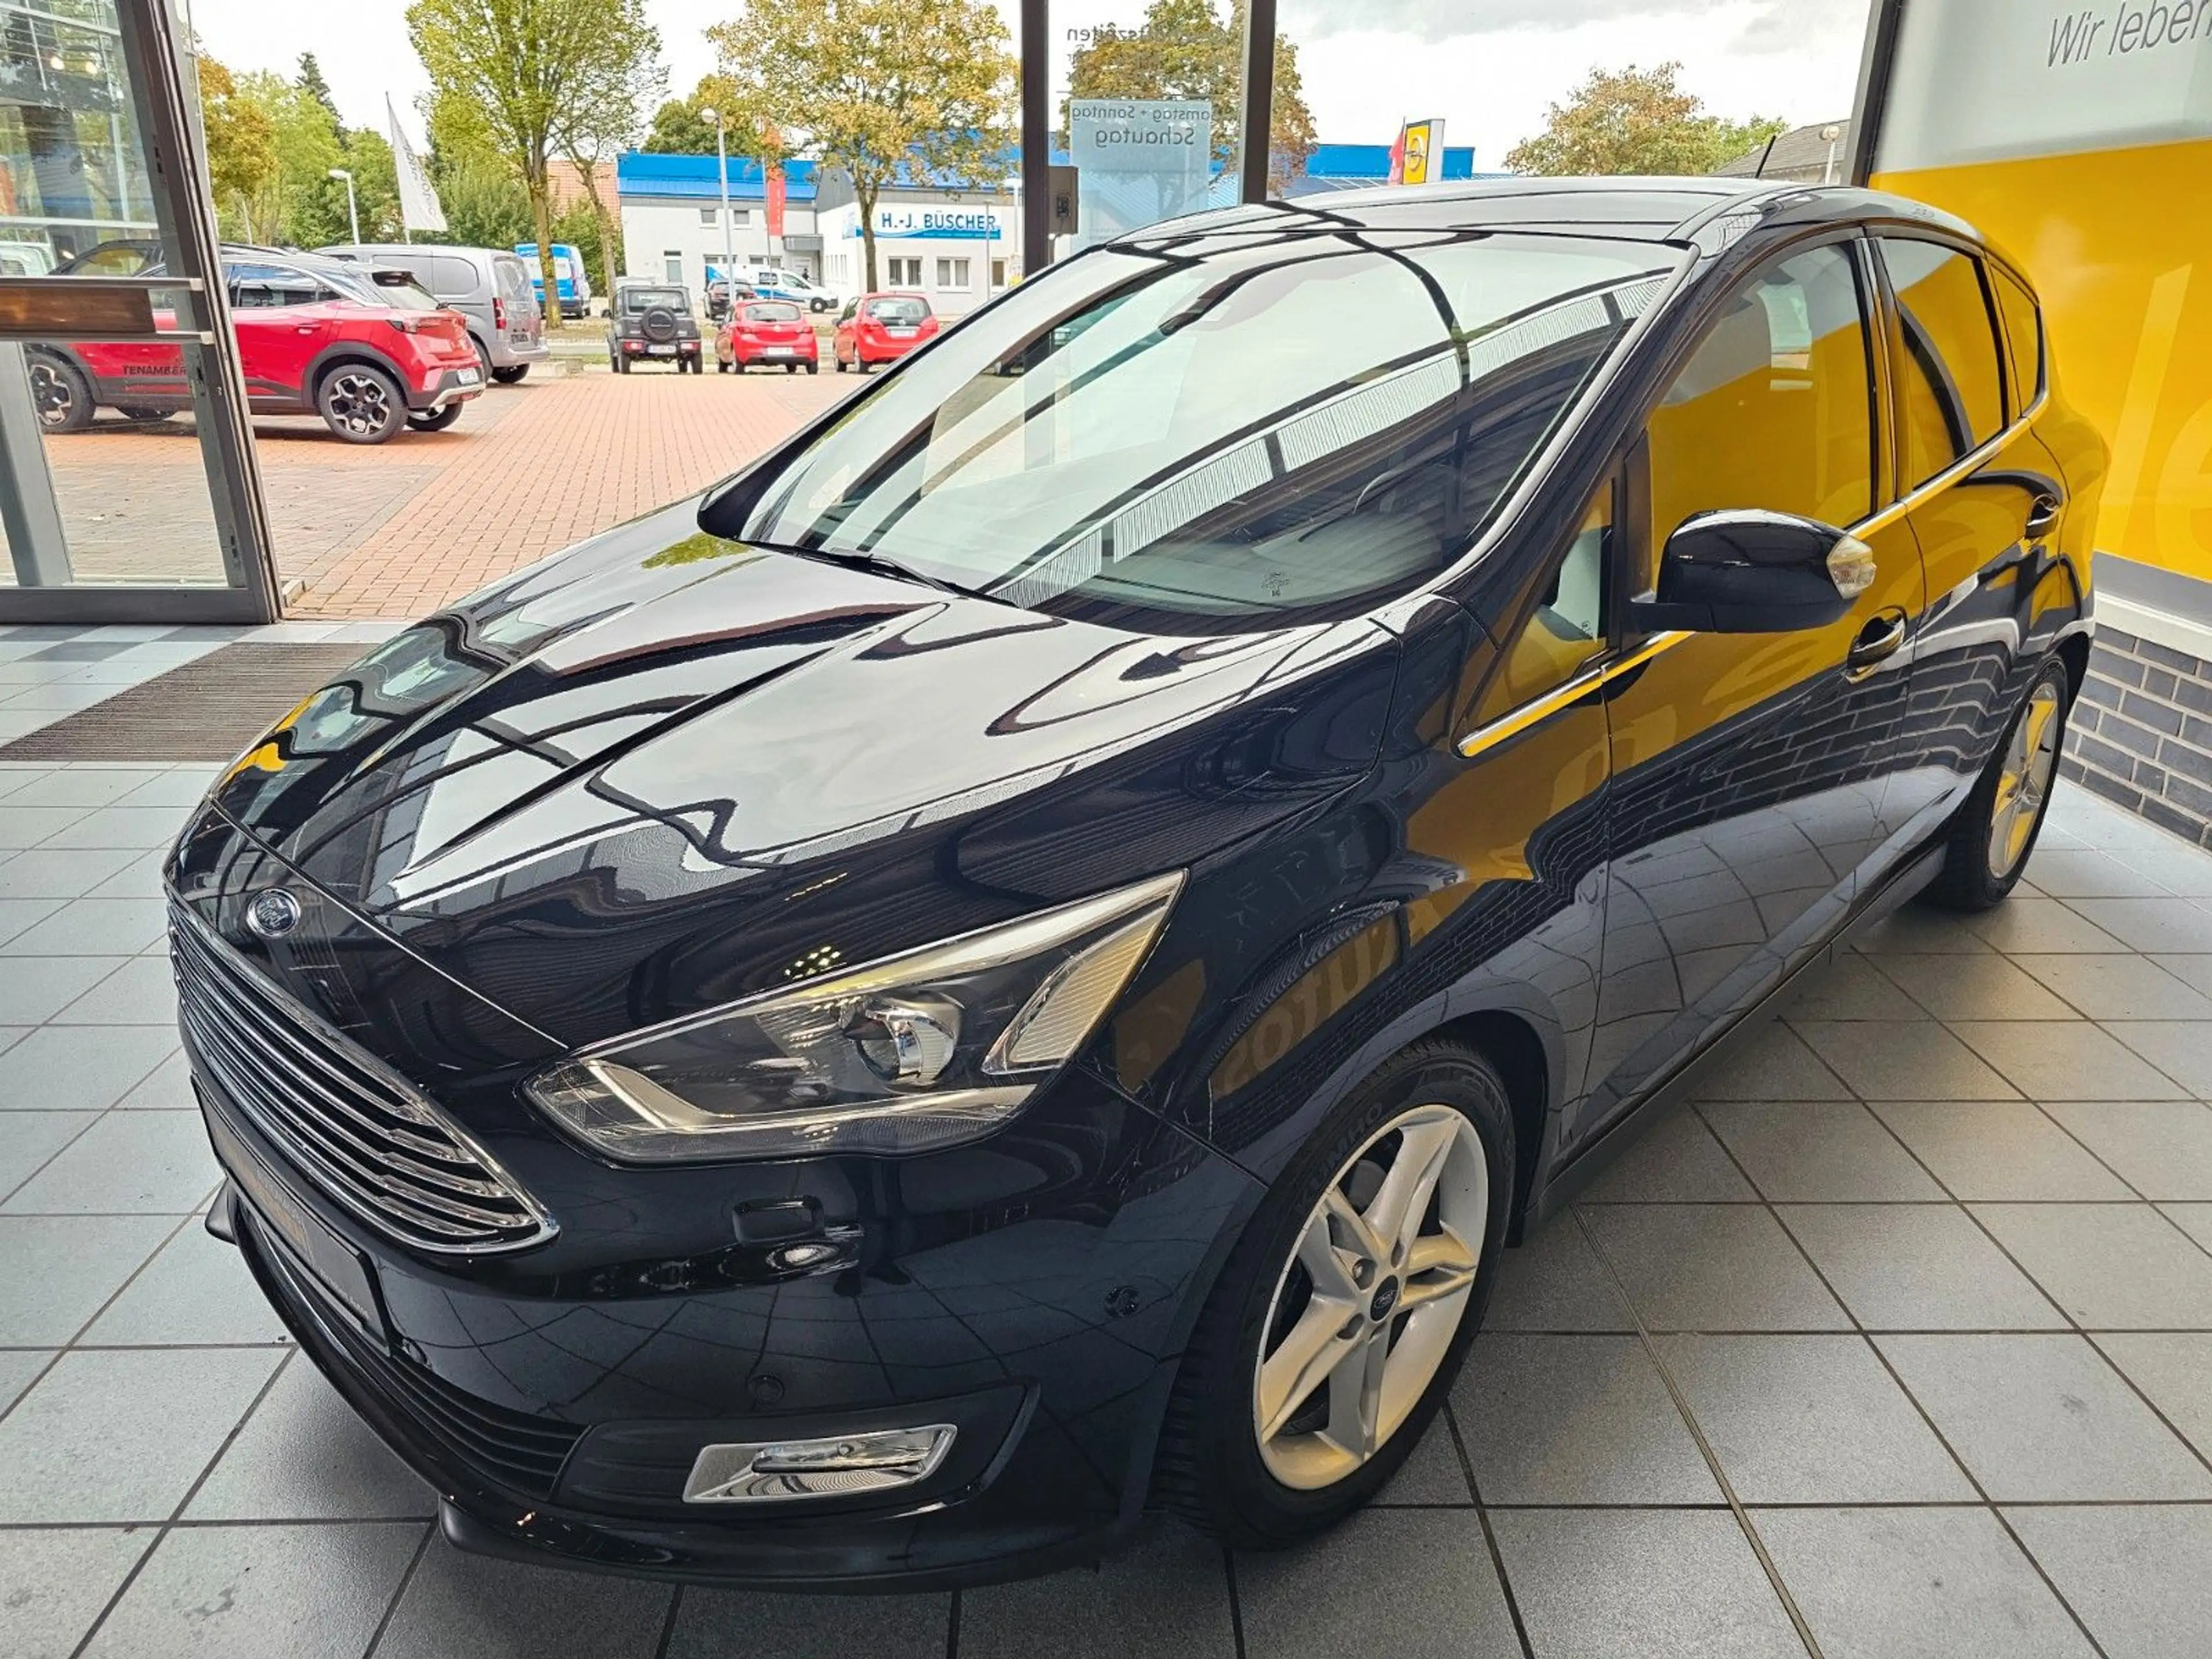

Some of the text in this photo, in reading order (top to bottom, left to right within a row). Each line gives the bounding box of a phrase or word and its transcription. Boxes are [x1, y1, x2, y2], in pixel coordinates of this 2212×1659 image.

[2048, 12, 2105, 67] Wir
[881, 210, 997, 230] H.-J. BÜSCHER
